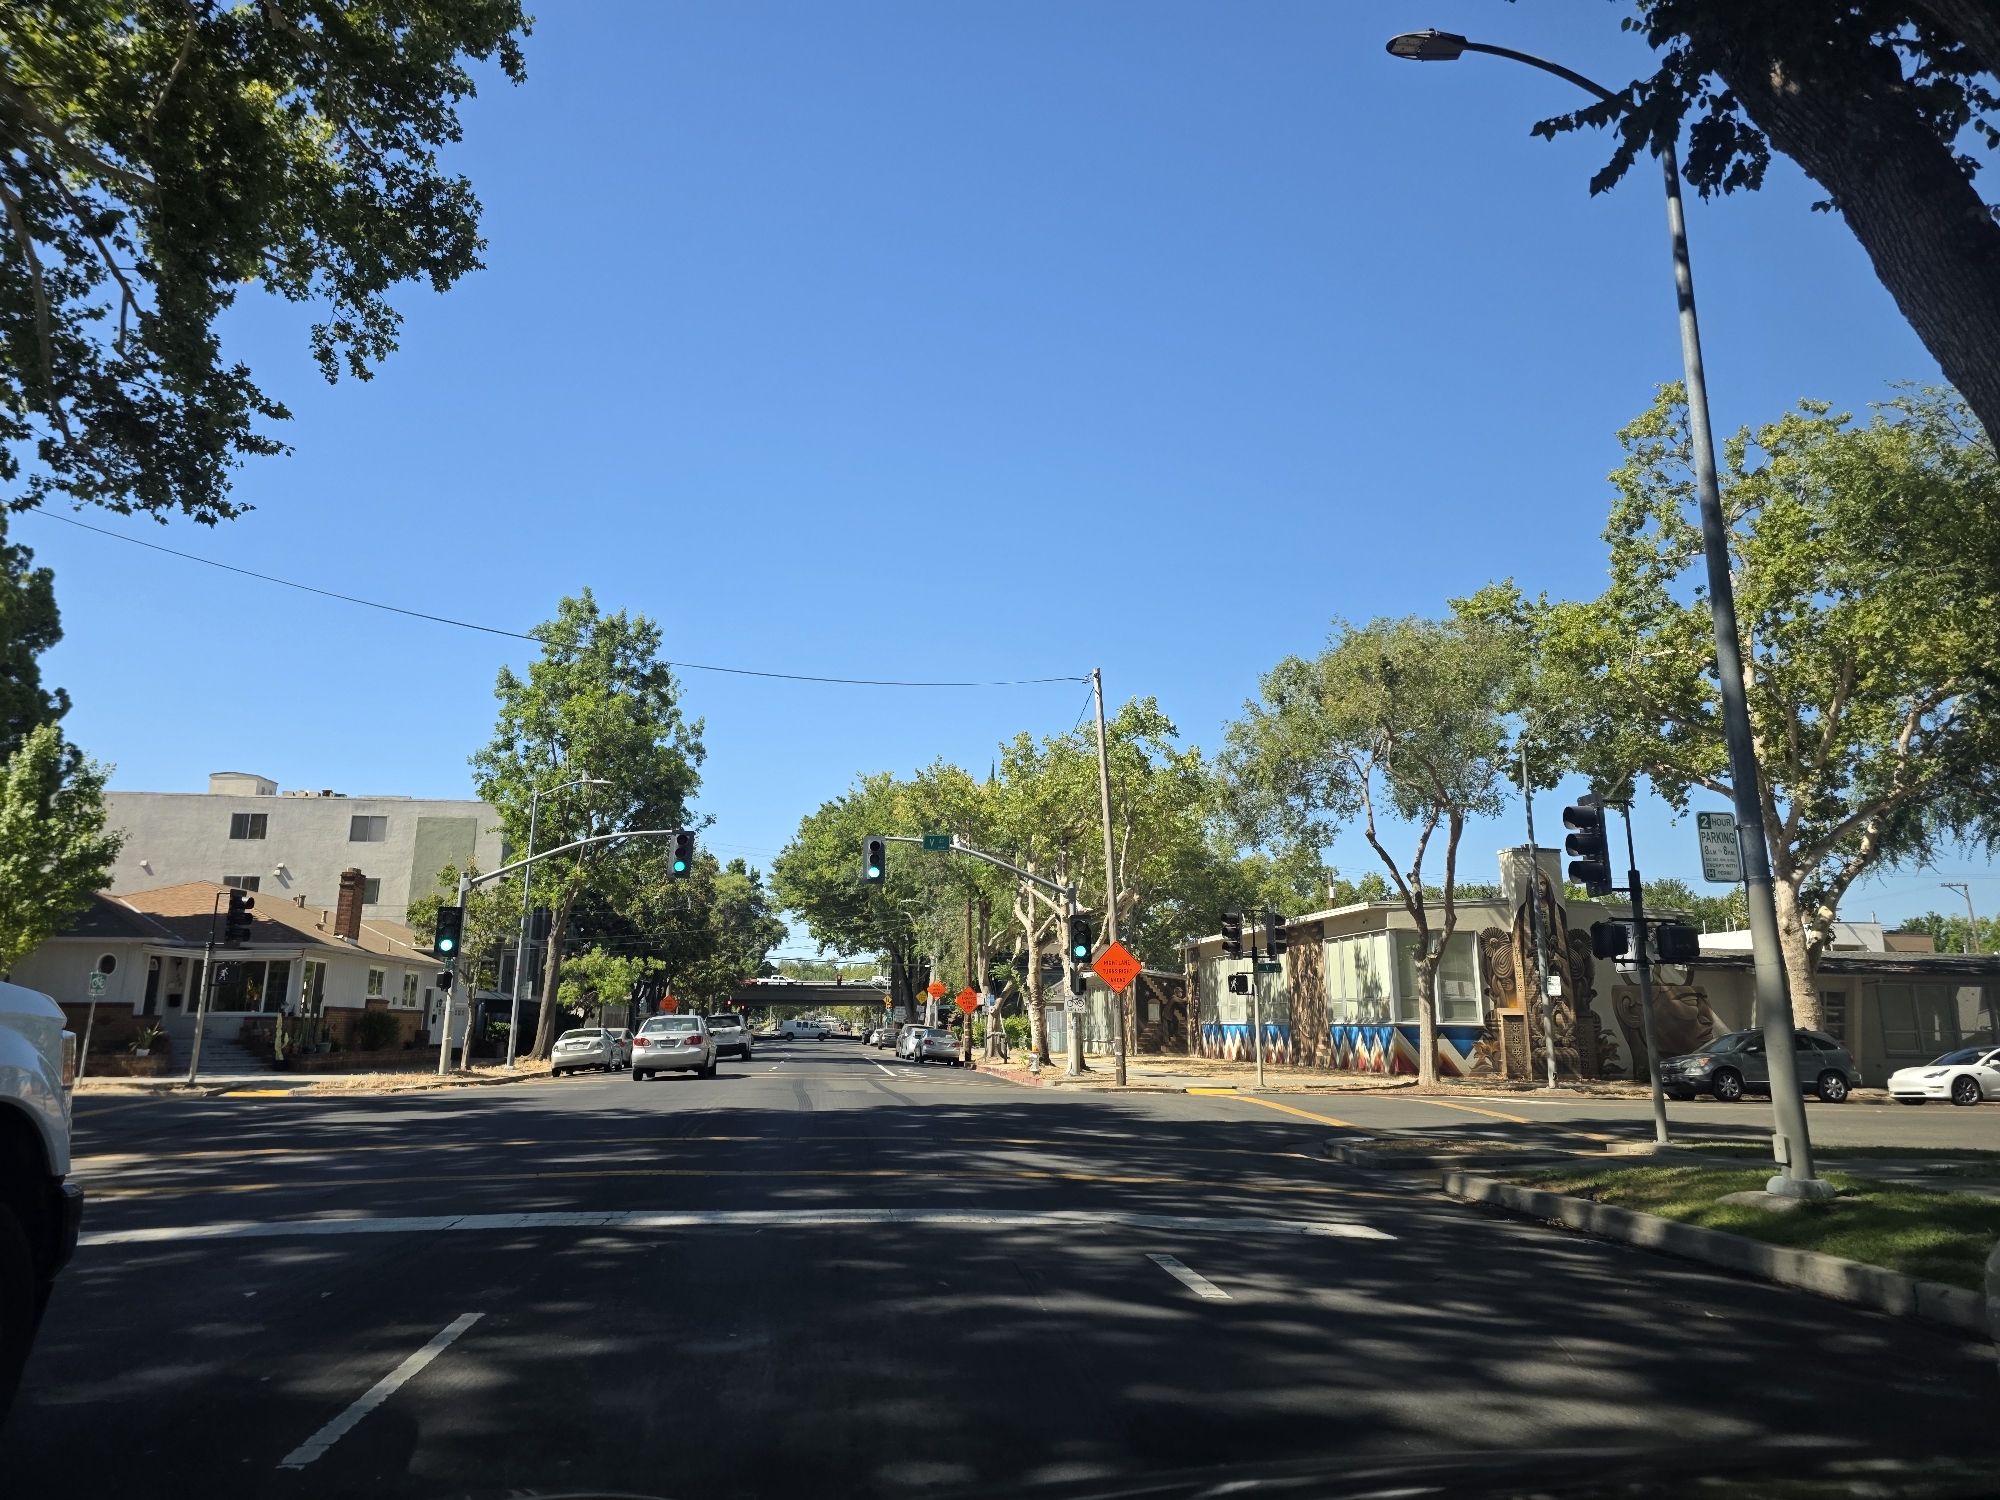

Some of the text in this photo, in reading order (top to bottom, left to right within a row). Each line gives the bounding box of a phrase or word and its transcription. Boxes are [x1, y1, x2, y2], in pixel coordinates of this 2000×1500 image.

[1700, 816, 1732, 826] 2 HOUR
[1701, 831, 1735, 843] PARKING
[929, 839, 934, 847] V
